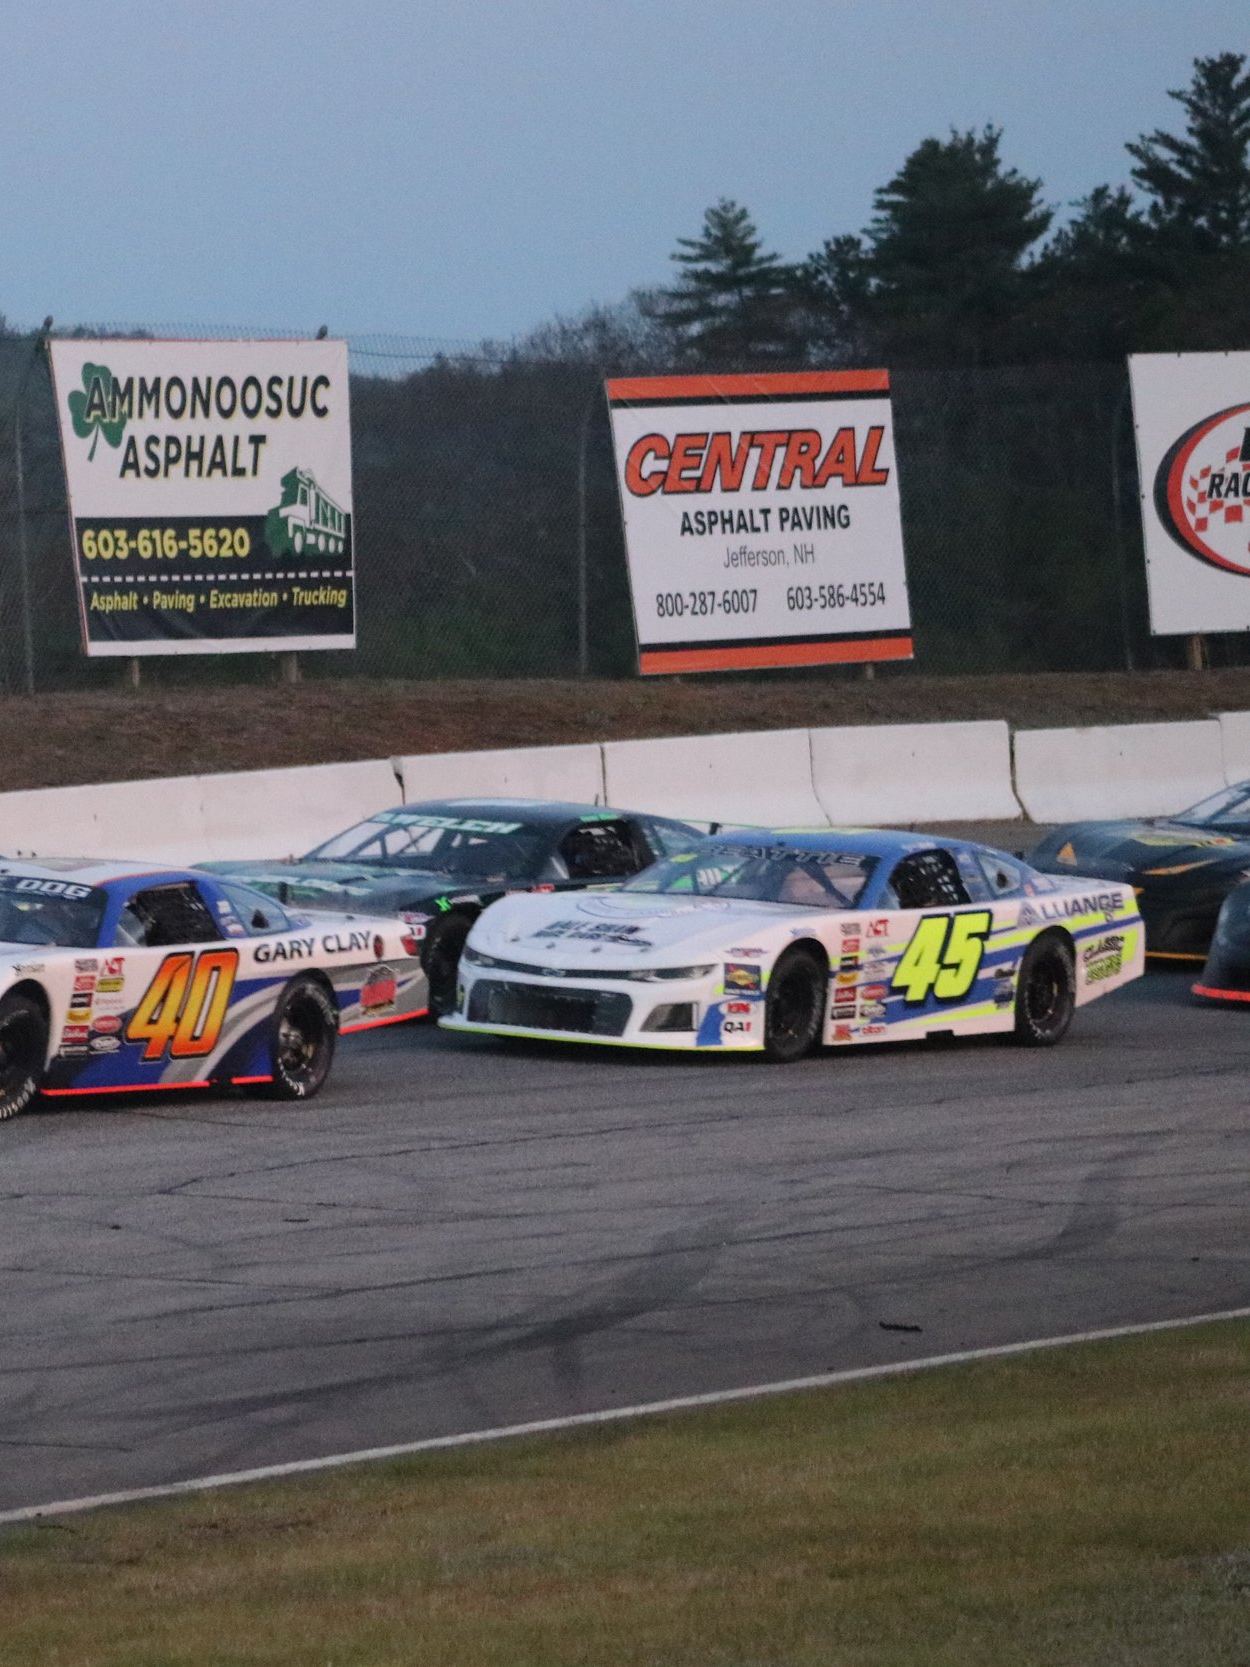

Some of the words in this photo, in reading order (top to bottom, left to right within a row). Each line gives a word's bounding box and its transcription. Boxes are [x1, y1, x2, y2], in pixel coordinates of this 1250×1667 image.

[85, 375, 331, 421] AMMONOOSUC
[119, 434, 266, 479] ASPHALT
[624, 425, 890, 497] CENTRAL
[680, 508, 771, 536] ASPHALT
[779, 504, 851, 530] PAVING
[82, 527, 250, 560] 603-616-5620
[723, 545, 790, 569] Jefferson,
[793, 543, 816, 564] NH
[91, 591, 138, 613] Asphalt
[153, 590, 195, 612] Paving
[209, 588, 277, 609] Excavation
[292, 586, 347, 608] Trucking
[656, 589, 757, 618] 800-287-6007
[786, 582, 886, 611] 603-586-4554
[15, 878, 93, 898] DOG
[253, 938, 314, 963] GARY
[322, 931, 371, 953] CLAY
[890, 908, 993, 1006] 45
[125, 947, 240, 1063] 40
